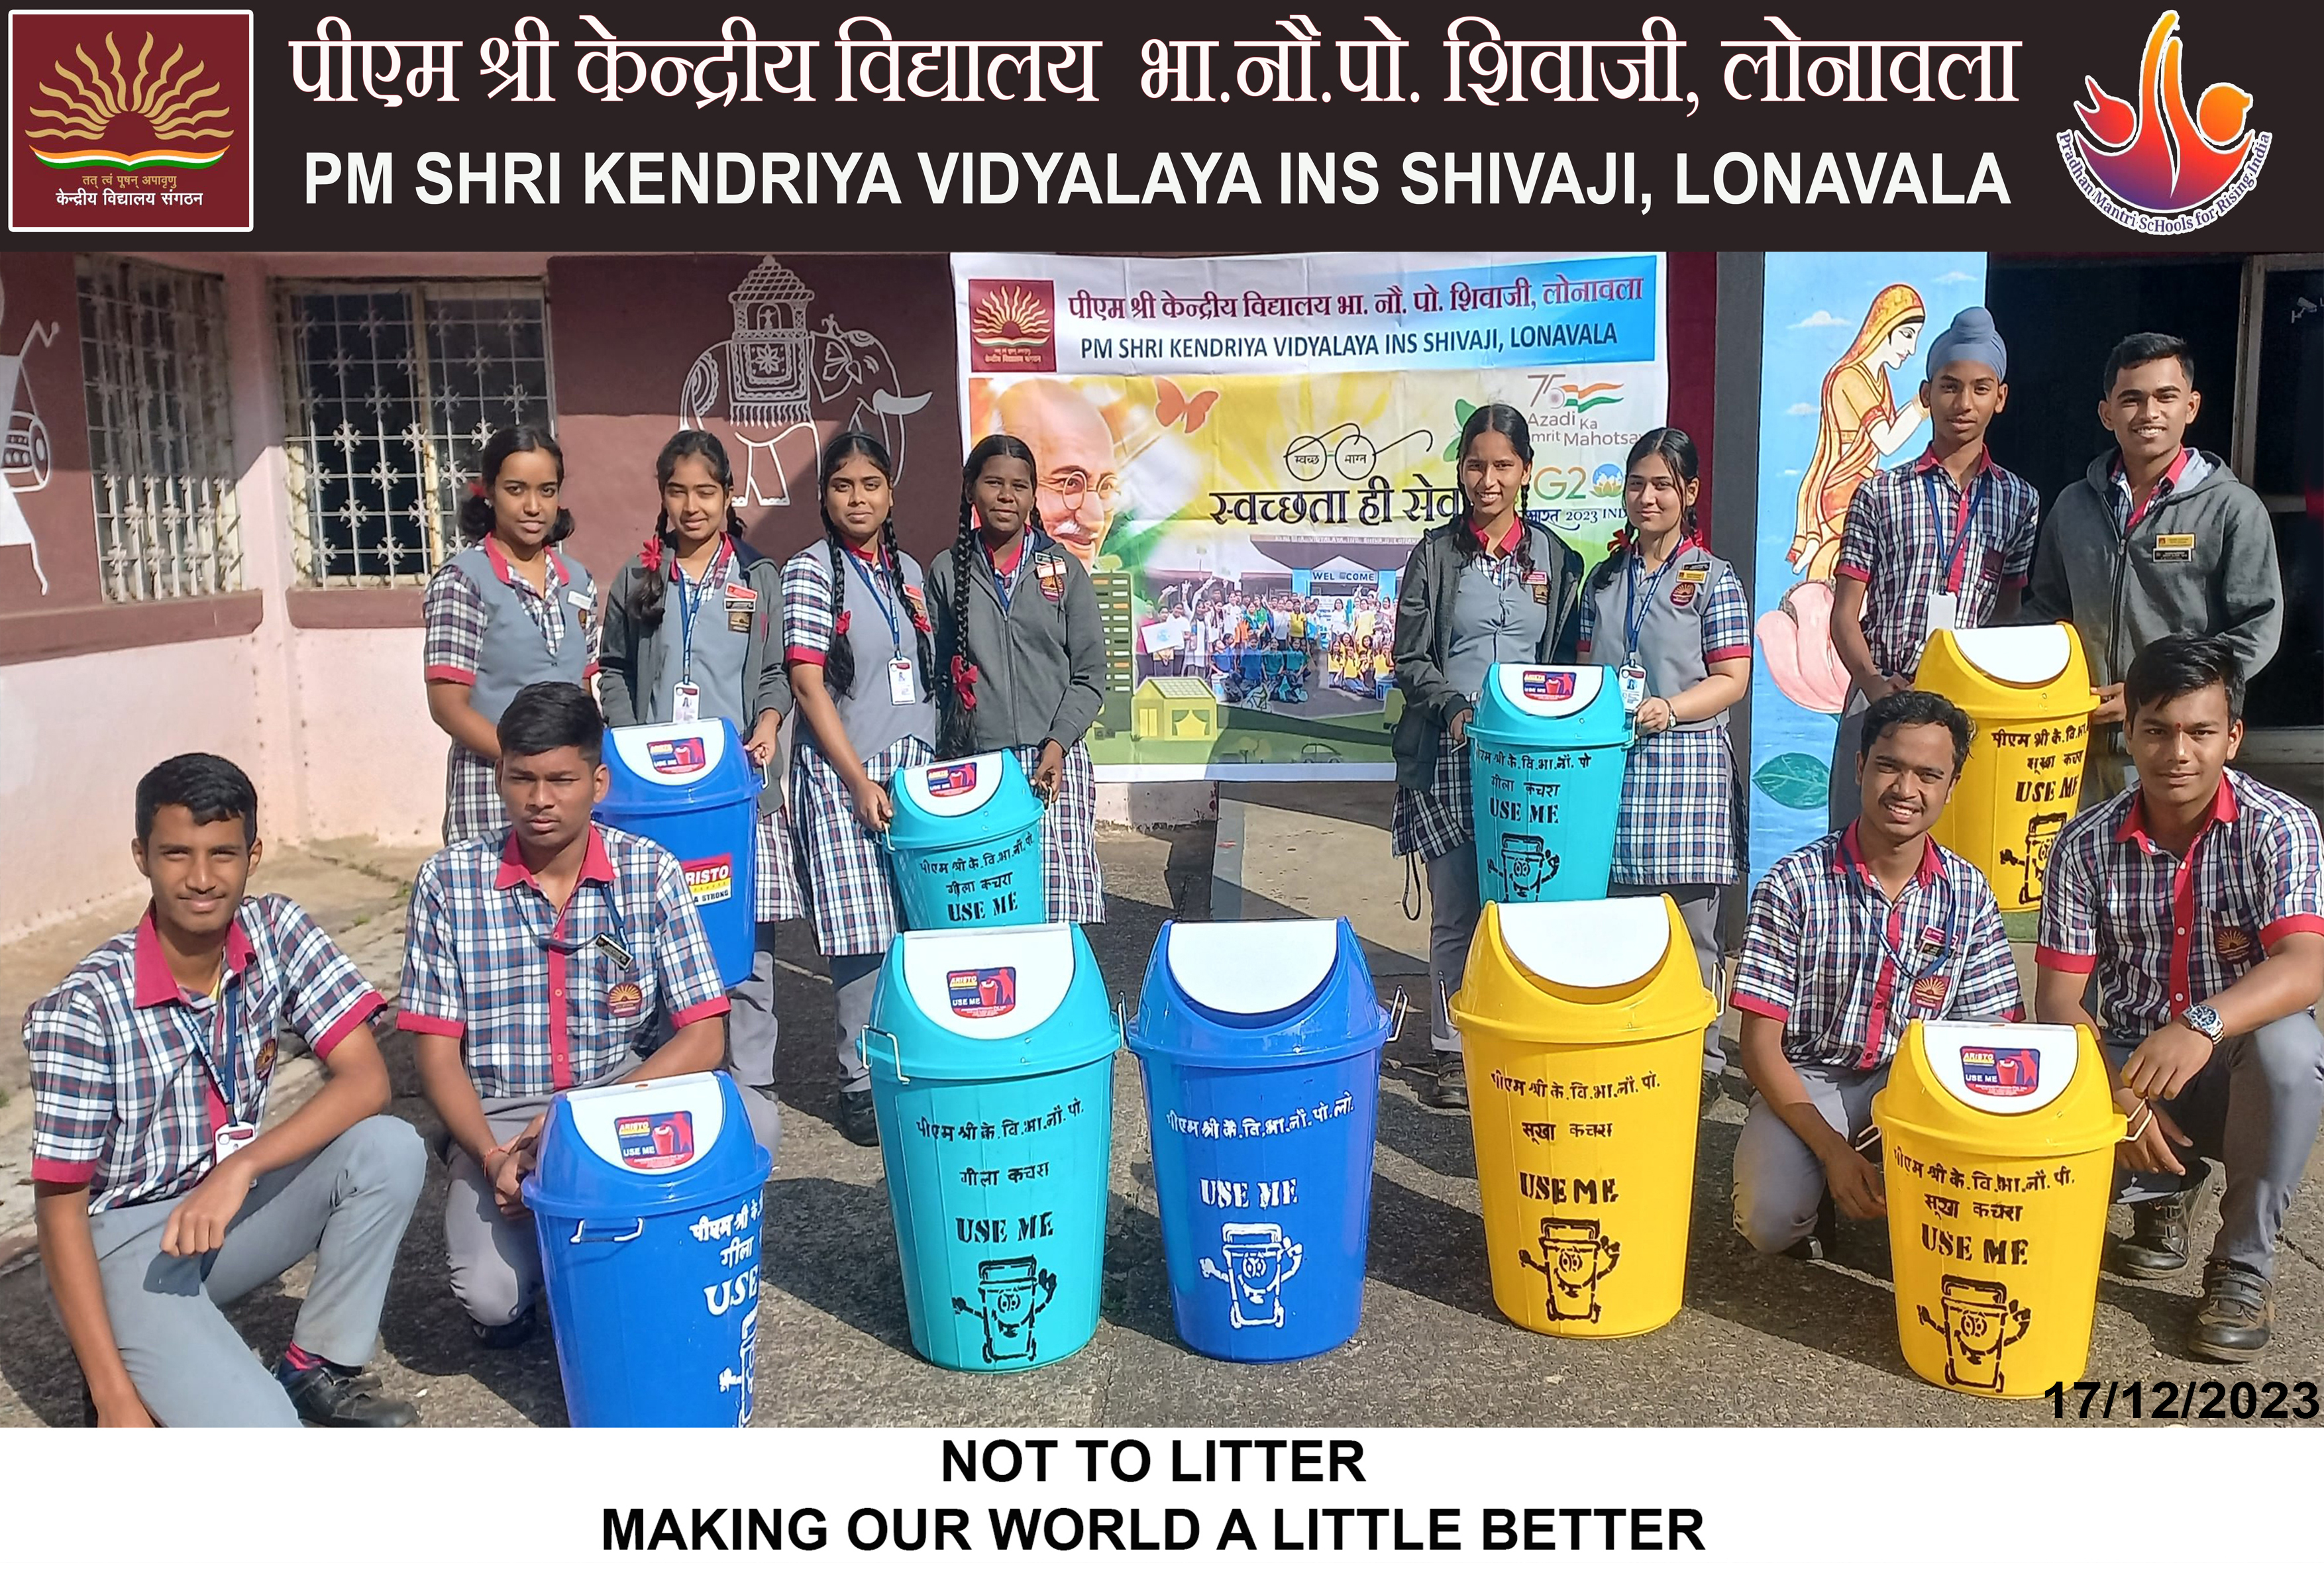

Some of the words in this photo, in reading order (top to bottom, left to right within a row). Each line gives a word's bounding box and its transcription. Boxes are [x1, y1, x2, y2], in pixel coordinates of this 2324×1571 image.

[1069, 289, 1126, 320] पीएम
[1130, 289, 1157, 319] श्री
[1161, 289, 1238, 321] केन्द्रीय
[1242, 289, 1331, 319] विद्यालय
[1450, 276, 1537, 311] शिवाजी,
[1542, 274, 1644, 306] लोनावला
[1081, 338, 1113, 359] PM
[1118, 338, 1163, 358] SHRI
[1170, 337, 1267, 358] KENDRIYA
[1276, 334, 1379, 358] VIDYALAYA
[1385, 332, 1418, 354] INS
[1423, 329, 1504, 354] SHIVAJI,
[1510, 323, 1617, 348] LONAVALA
[1528, 411, 1575, 427] Azadi
[1580, 419, 1598, 430] Ka
[1531, 430, 1561, 442] mrit
[1209, 490, 1350, 526] स्वच्छता
[1358, 474, 1395, 526] ही
[1402, 473, 1460, 522] सेव
[1566, 511, 1598, 523] 2023
[1603, 508, 1627, 519] IND
[1312, 572, 1335, 580] WEL
[1991, 729, 2032, 748] पीएम
[1523, 782, 1561, 797] कचरा
[2015, 781, 2056, 802] USE
[2058, 775, 2080, 799] ME
[1490, 797, 1521, 821] USE
[1530, 804, 1559, 824] ME
[685, 864, 729, 886] RISTO
[980, 872, 1013, 891] कचरा
[947, 901, 986, 922] USE
[992, 891, 1018, 917] ME
[1521, 1121, 1557, 1145] सूखा
[1569, 1123, 1612, 1138] कचरा
[623, 1147, 641, 1157] USE
[642, 1145, 655, 1155] ME
[960, 1167, 999, 1188] गीला
[1008, 1162, 1049, 1184] कचरा
[1519, 1171, 1567, 1205] USE
[1573, 1178, 1619, 1205] ME
[1200, 1177, 1251, 1209] USE
[1257, 1178, 1299, 1210] ME
[1924, 1193, 1960, 1221] सूखा
[955, 1217, 1008, 1244] USE
[1018, 1211, 1054, 1242] ME
[720, 1237, 755, 1270] गीला
[1921, 1222, 1973, 1261] USE
[1983, 1239, 2030, 1266] ME
[703, 1264, 759, 1316] USE
